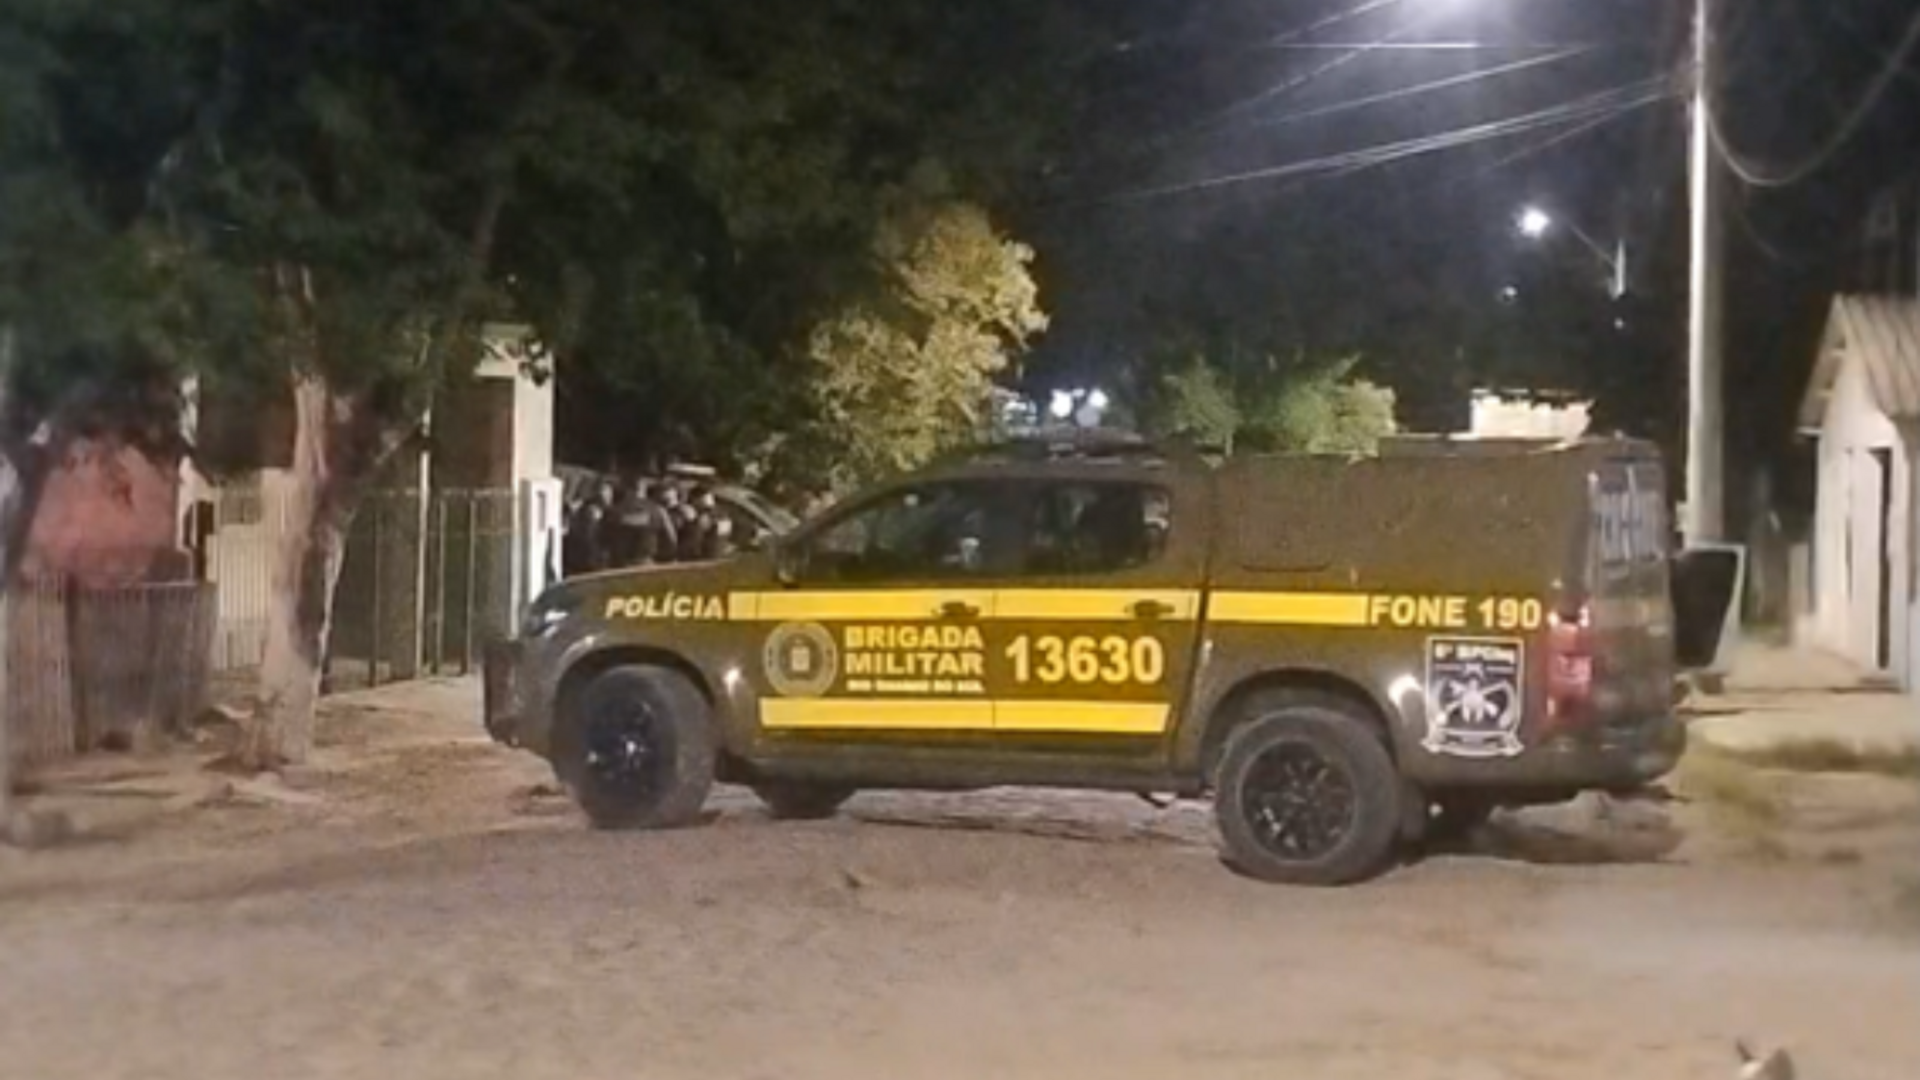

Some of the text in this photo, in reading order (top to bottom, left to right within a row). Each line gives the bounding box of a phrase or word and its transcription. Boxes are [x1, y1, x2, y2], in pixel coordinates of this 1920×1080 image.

[605, 590, 724, 620] POLÍCIA
[1371, 595, 1542, 628] FONE 190
[845, 625, 984, 649] BRIGADA
[845, 652, 984, 675] MILITAR
[1005, 635, 1163, 682] 13630
